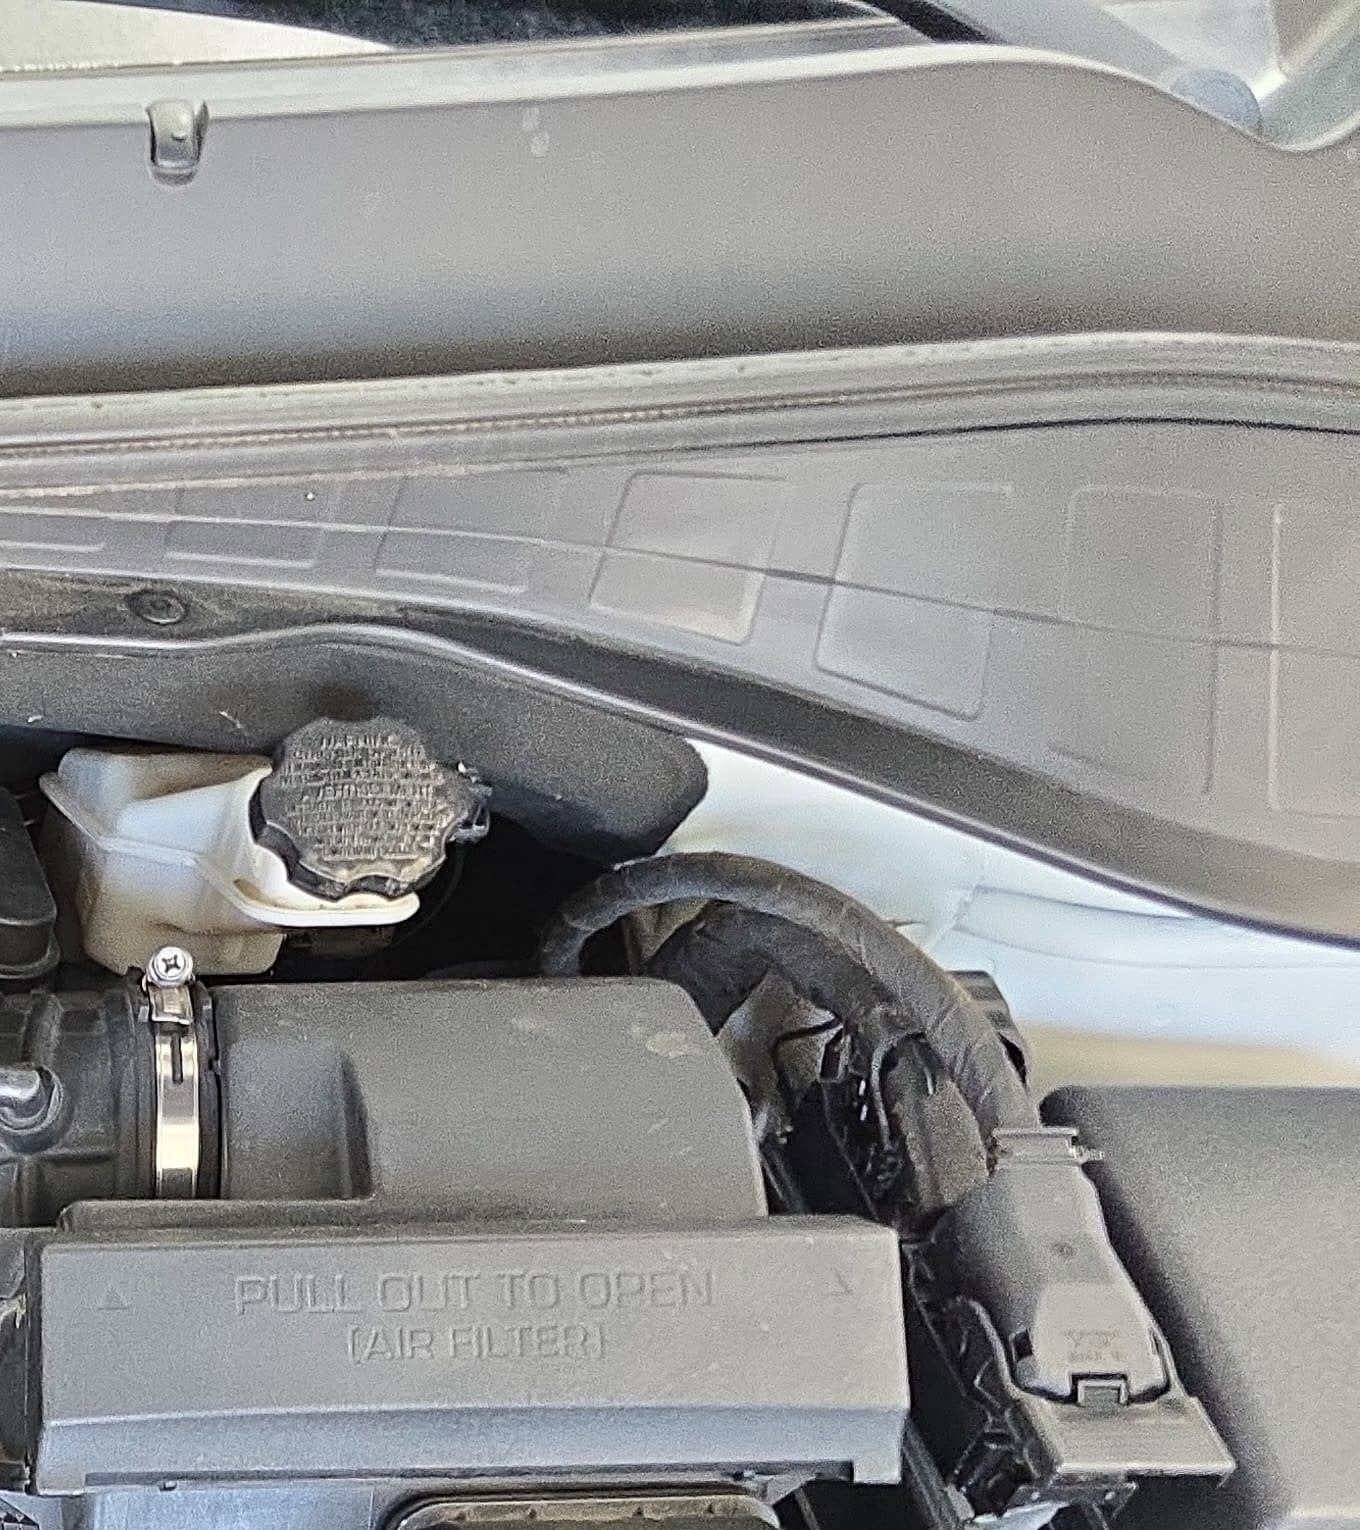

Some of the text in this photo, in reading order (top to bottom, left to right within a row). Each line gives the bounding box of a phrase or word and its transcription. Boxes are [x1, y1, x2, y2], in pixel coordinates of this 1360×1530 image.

[234, 1270, 715, 1316] PULL OUT TO OPEN
